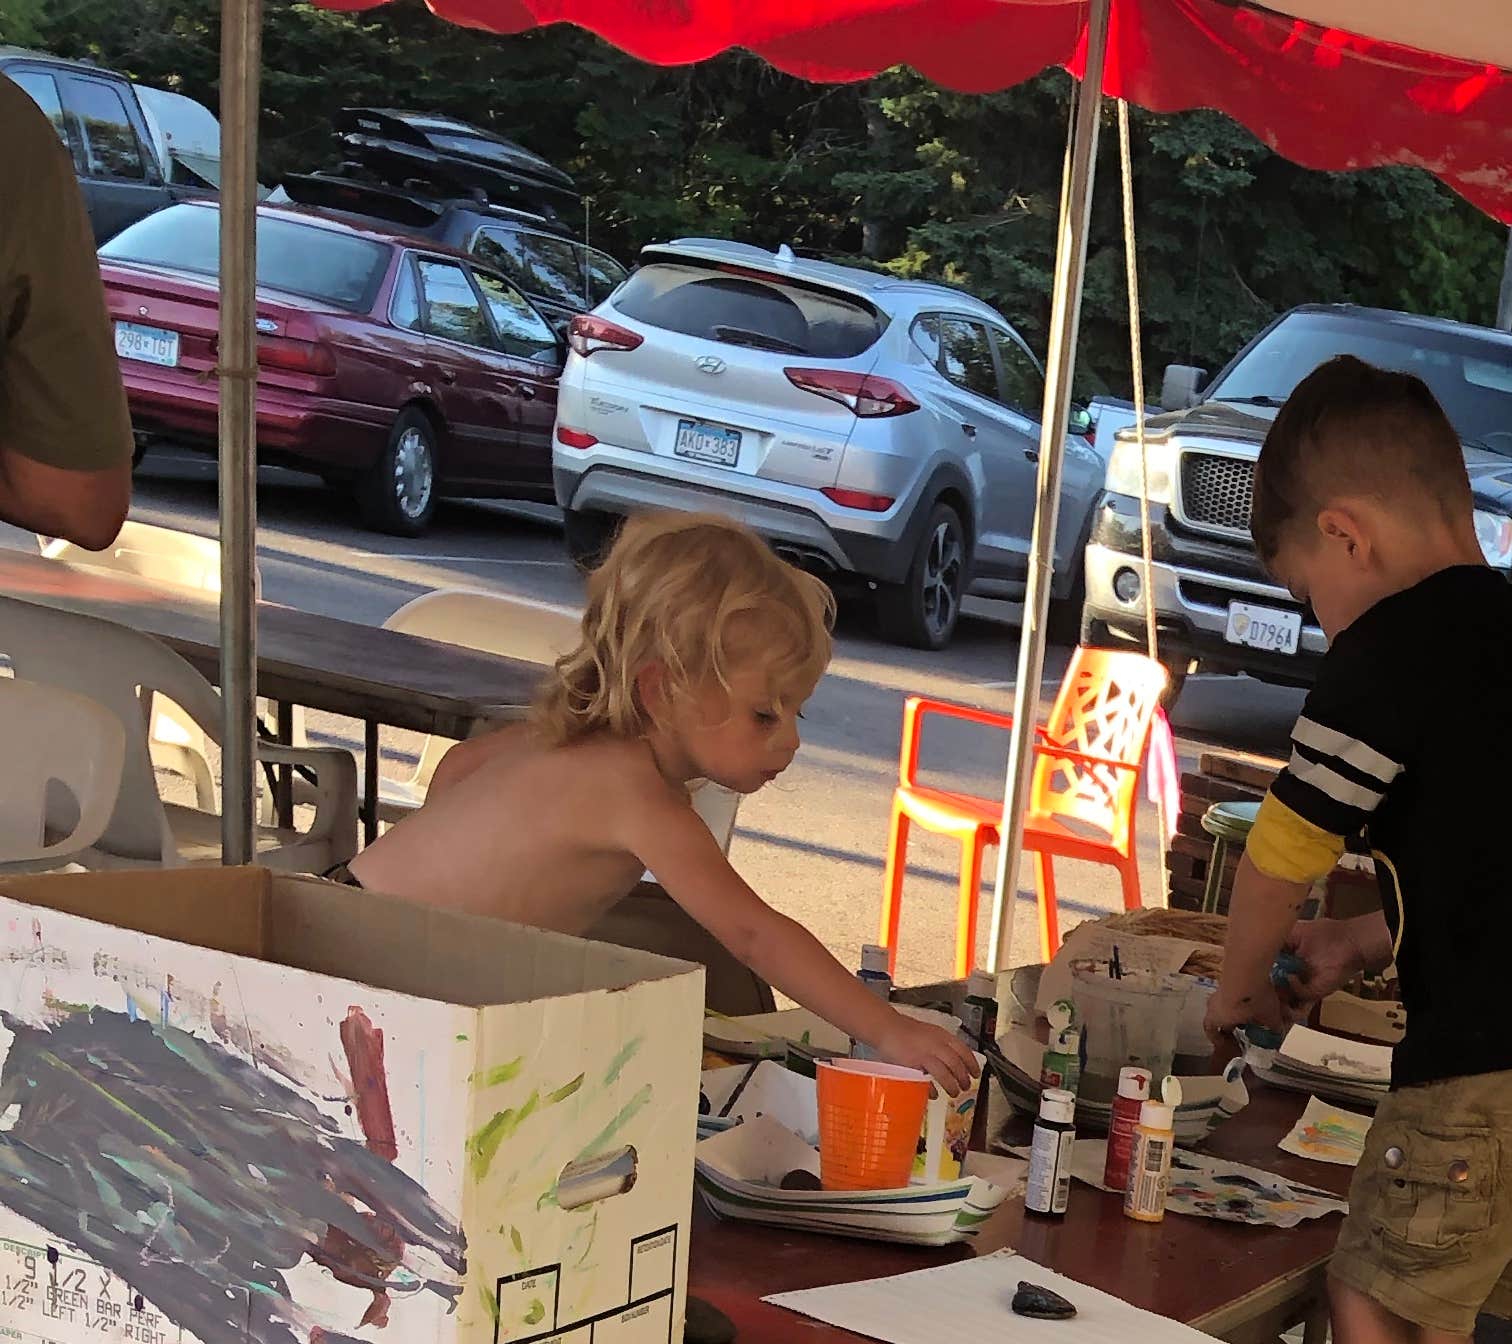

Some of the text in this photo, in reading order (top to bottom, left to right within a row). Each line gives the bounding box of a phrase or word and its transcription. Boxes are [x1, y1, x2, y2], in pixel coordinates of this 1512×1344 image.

[25, 1255, 36, 1280] 9
[99, 1273, 112, 1299] X
[42, 1299, 75, 1323] LEFT
[96, 1299, 121, 1319] BAR
[129, 1308, 162, 1329] PERF
